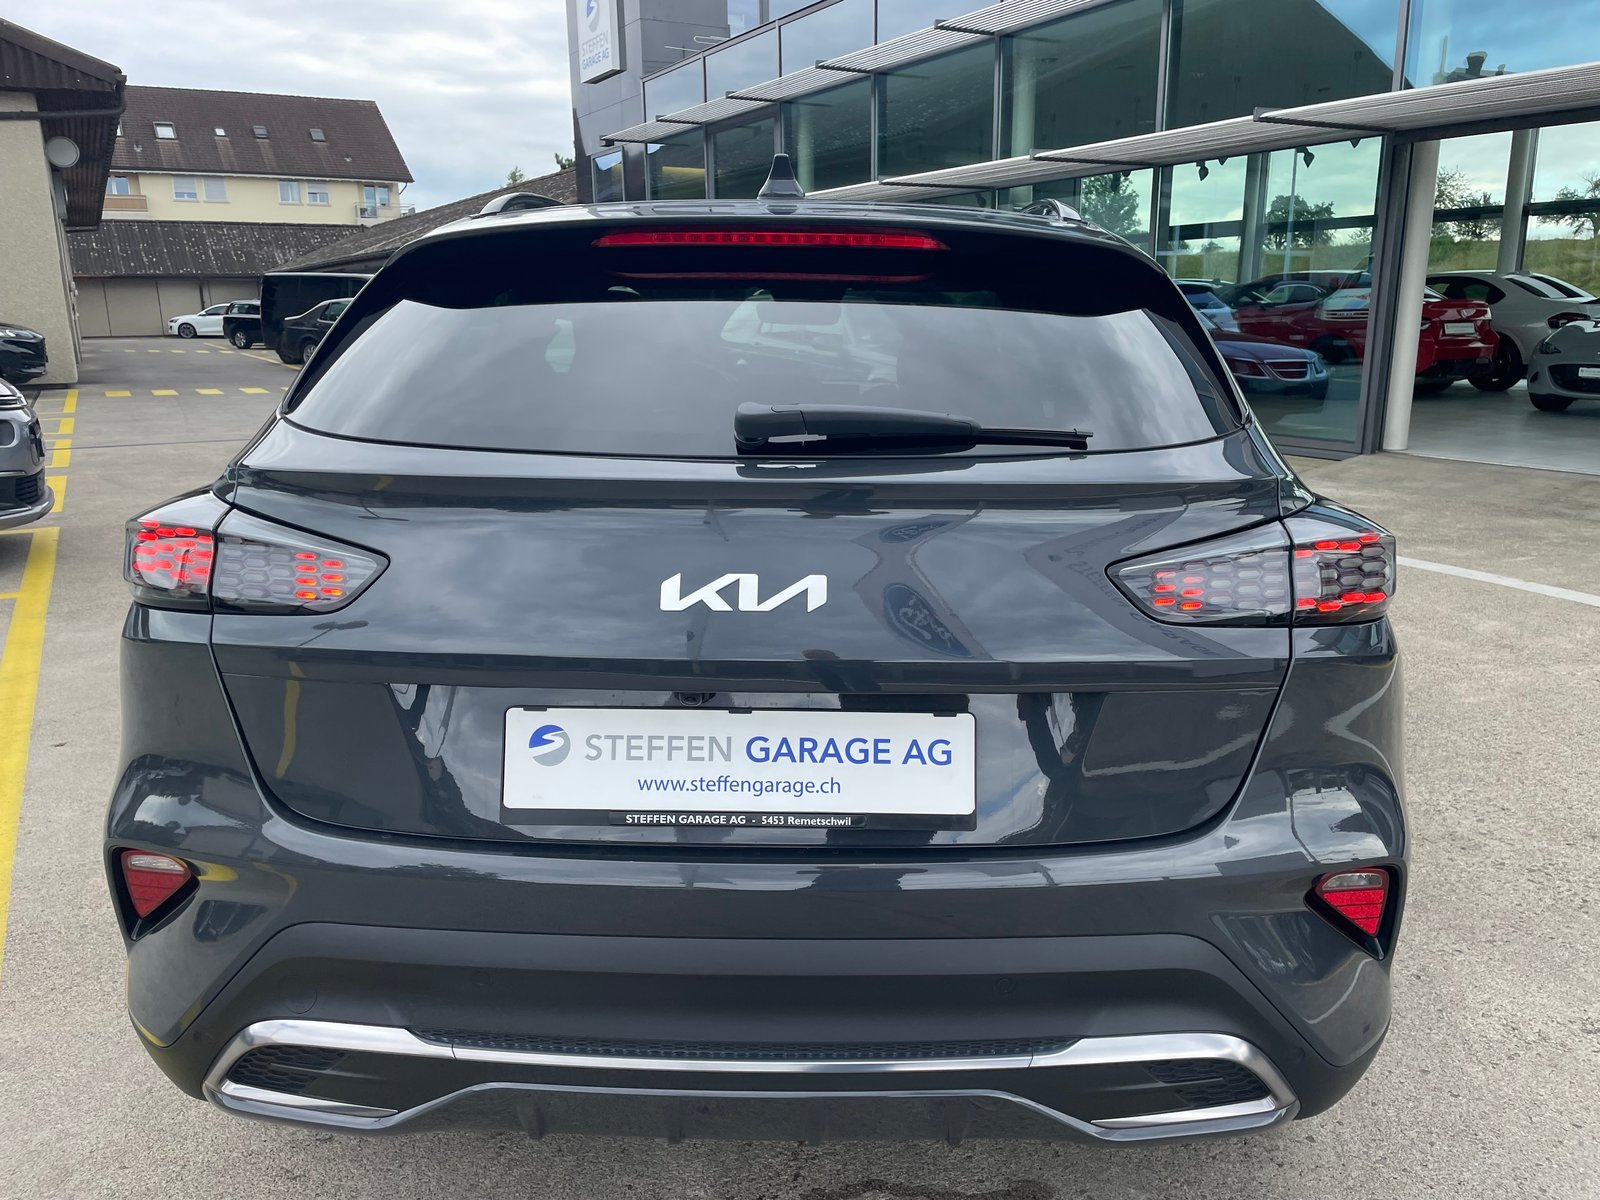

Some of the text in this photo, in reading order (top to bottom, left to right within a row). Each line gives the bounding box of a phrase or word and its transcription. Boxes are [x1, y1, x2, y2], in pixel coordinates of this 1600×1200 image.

[582, 30, 609, 57] STEFFEN
[582, 47, 610, 70] GARAGE AG
[659, 572, 828, 613] KIA
[584, 733, 953, 767] STEFFEN GARAGE AG
[637, 774, 841, 798] www.steffengarage.ch
[625, 814, 676, 824] STEFFEN
[678, 814, 727, 825] GARAGE
[729, 815, 746, 825] AG
[761, 815, 785, 825] 5453
[787, 815, 852, 826] Remetschwil
